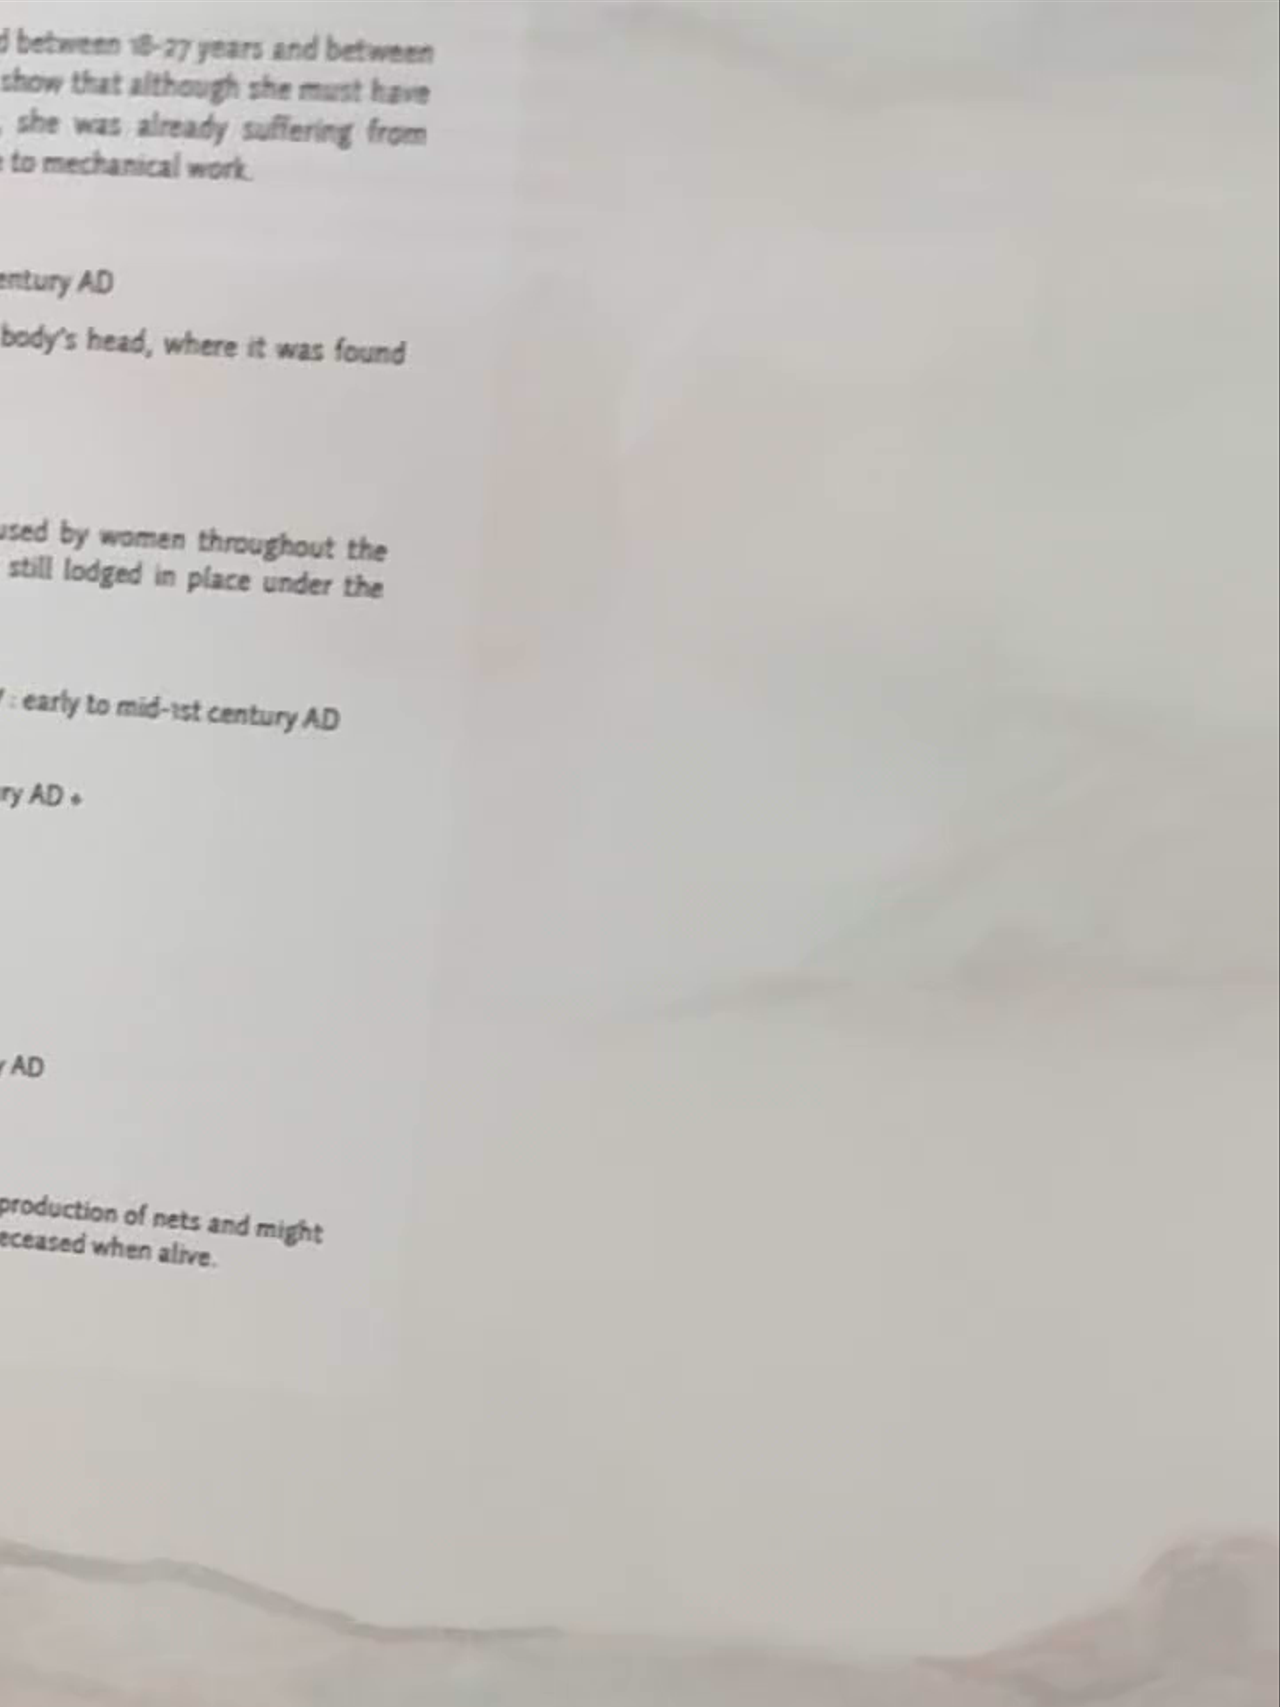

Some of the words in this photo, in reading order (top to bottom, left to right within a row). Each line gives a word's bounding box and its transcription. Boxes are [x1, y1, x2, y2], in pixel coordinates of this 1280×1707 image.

[76, 269, 114, 295] AD
[59, 519, 90, 551] by
[99, 530, 186, 550] women
[198, 527, 336, 563] throughout
[347, 536, 388, 562] the
[7, 554, 53, 580] still
[63, 557, 143, 589] lodged
[154, 564, 177, 587] in
[186, 565, 252, 594] place
[262, 570, 334, 596] under
[343, 574, 384, 599] the
[22, 689, 81, 720] early
[85, 693, 111, 716] to
[115, 695, 202, 722] mid-1st
[206, 704, 299, 734] century
[301, 706, 341, 731] AD
[28, 782, 65, 807] AD
[10, 1054, 45, 1078] AD
[123, 1203, 149, 1226] of
[152, 1211, 202, 1232] nets
[206, 1214, 251, 1237] and
[255, 1219, 324, 1248] might
[90, 1235, 152, 1260] when
[158, 1241, 217, 1267] alive.
